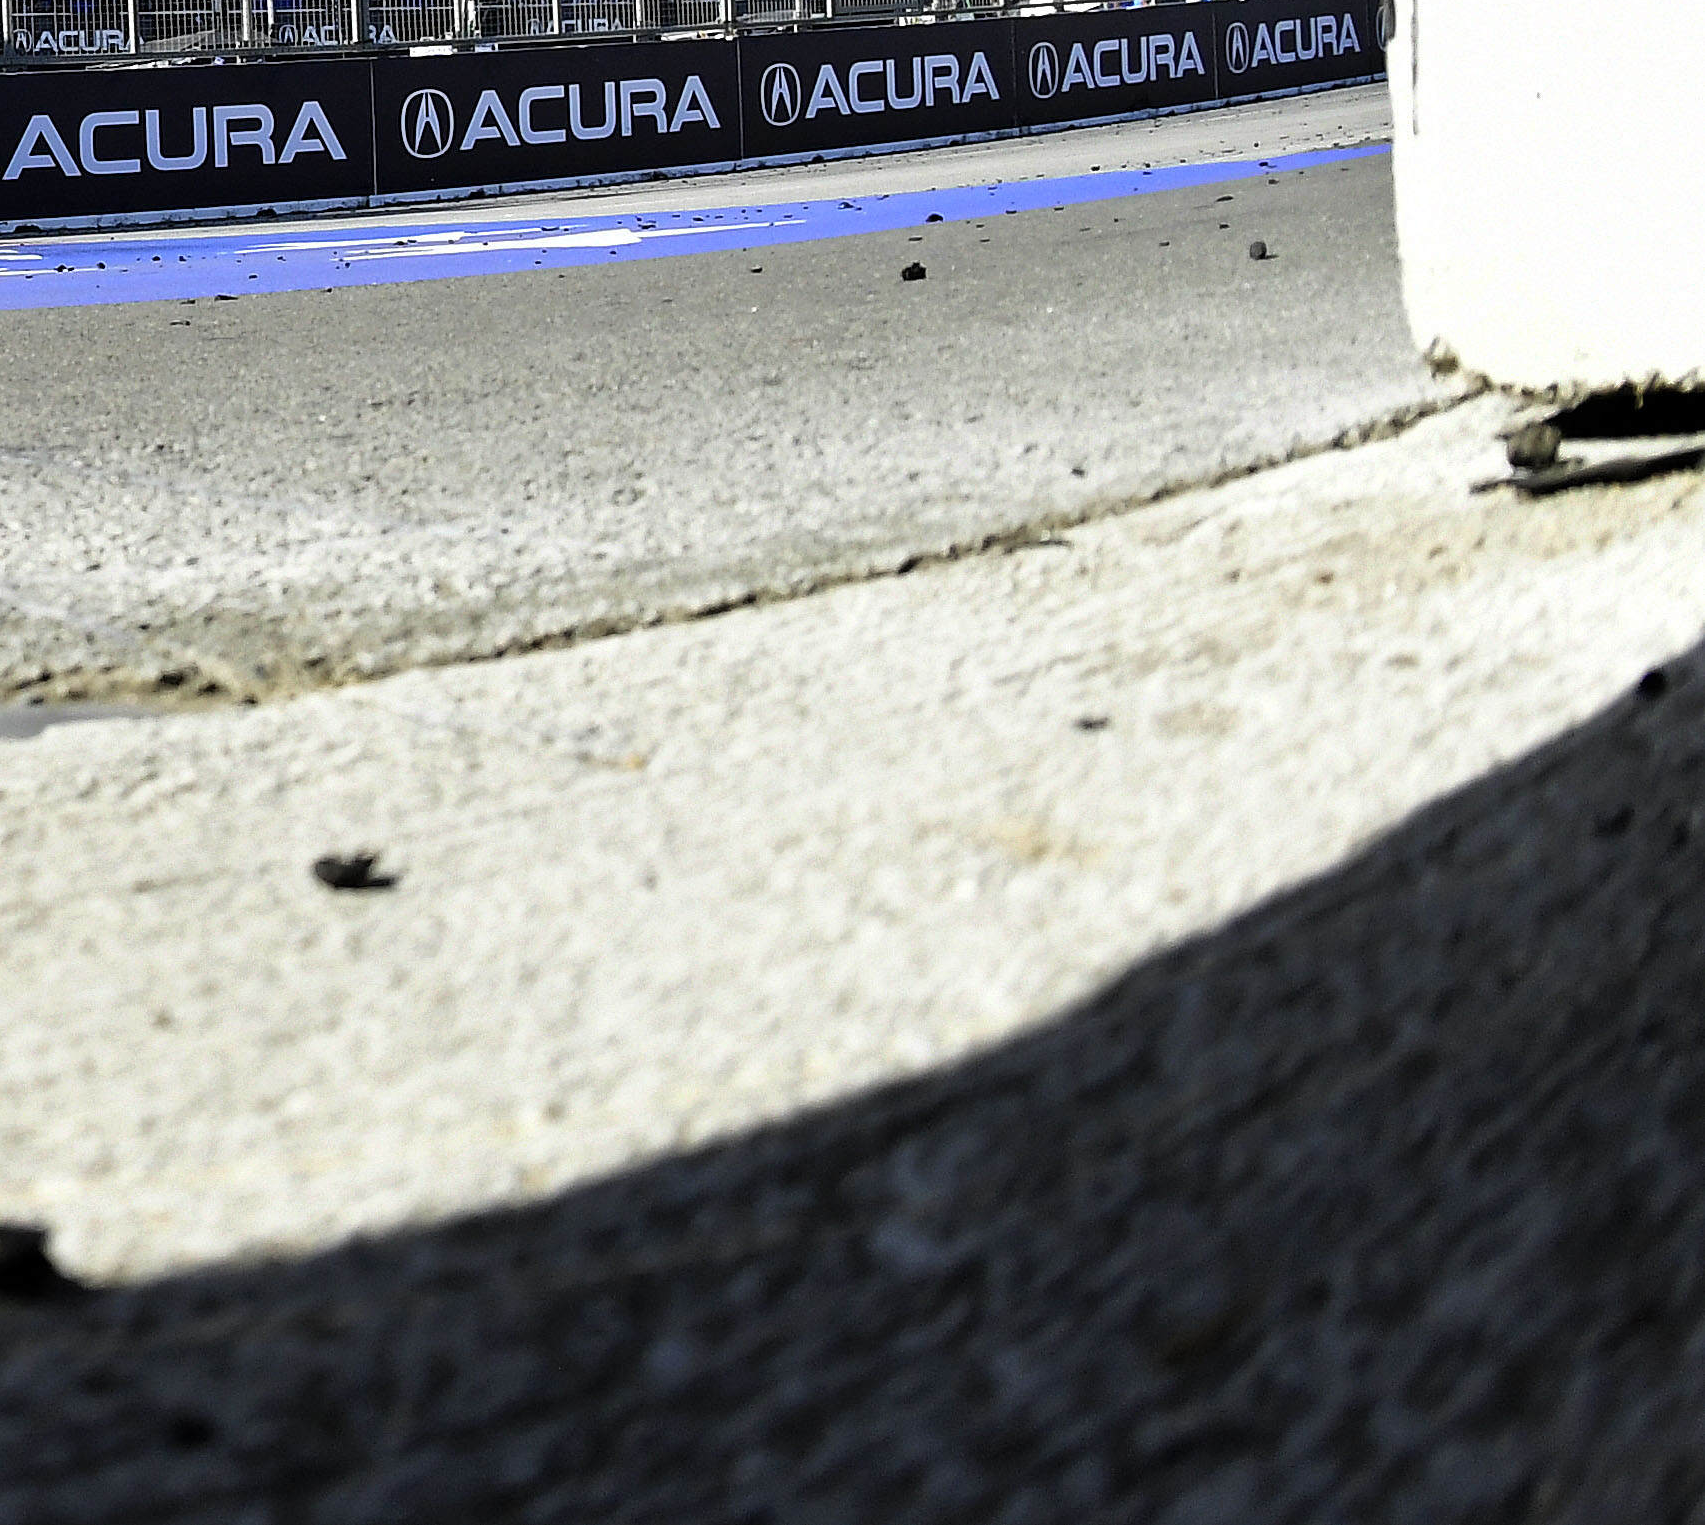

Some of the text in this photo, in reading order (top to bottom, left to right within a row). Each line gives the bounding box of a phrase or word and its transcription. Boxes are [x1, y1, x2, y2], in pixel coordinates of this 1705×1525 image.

[1062, 32, 1206, 92] ACURA
[1252, 14, 1360, 67] ACURA
[460, 76, 721, 150] ACURA
[806, 52, 999, 118] ACURA
[2, 101, 347, 180] ACURA
